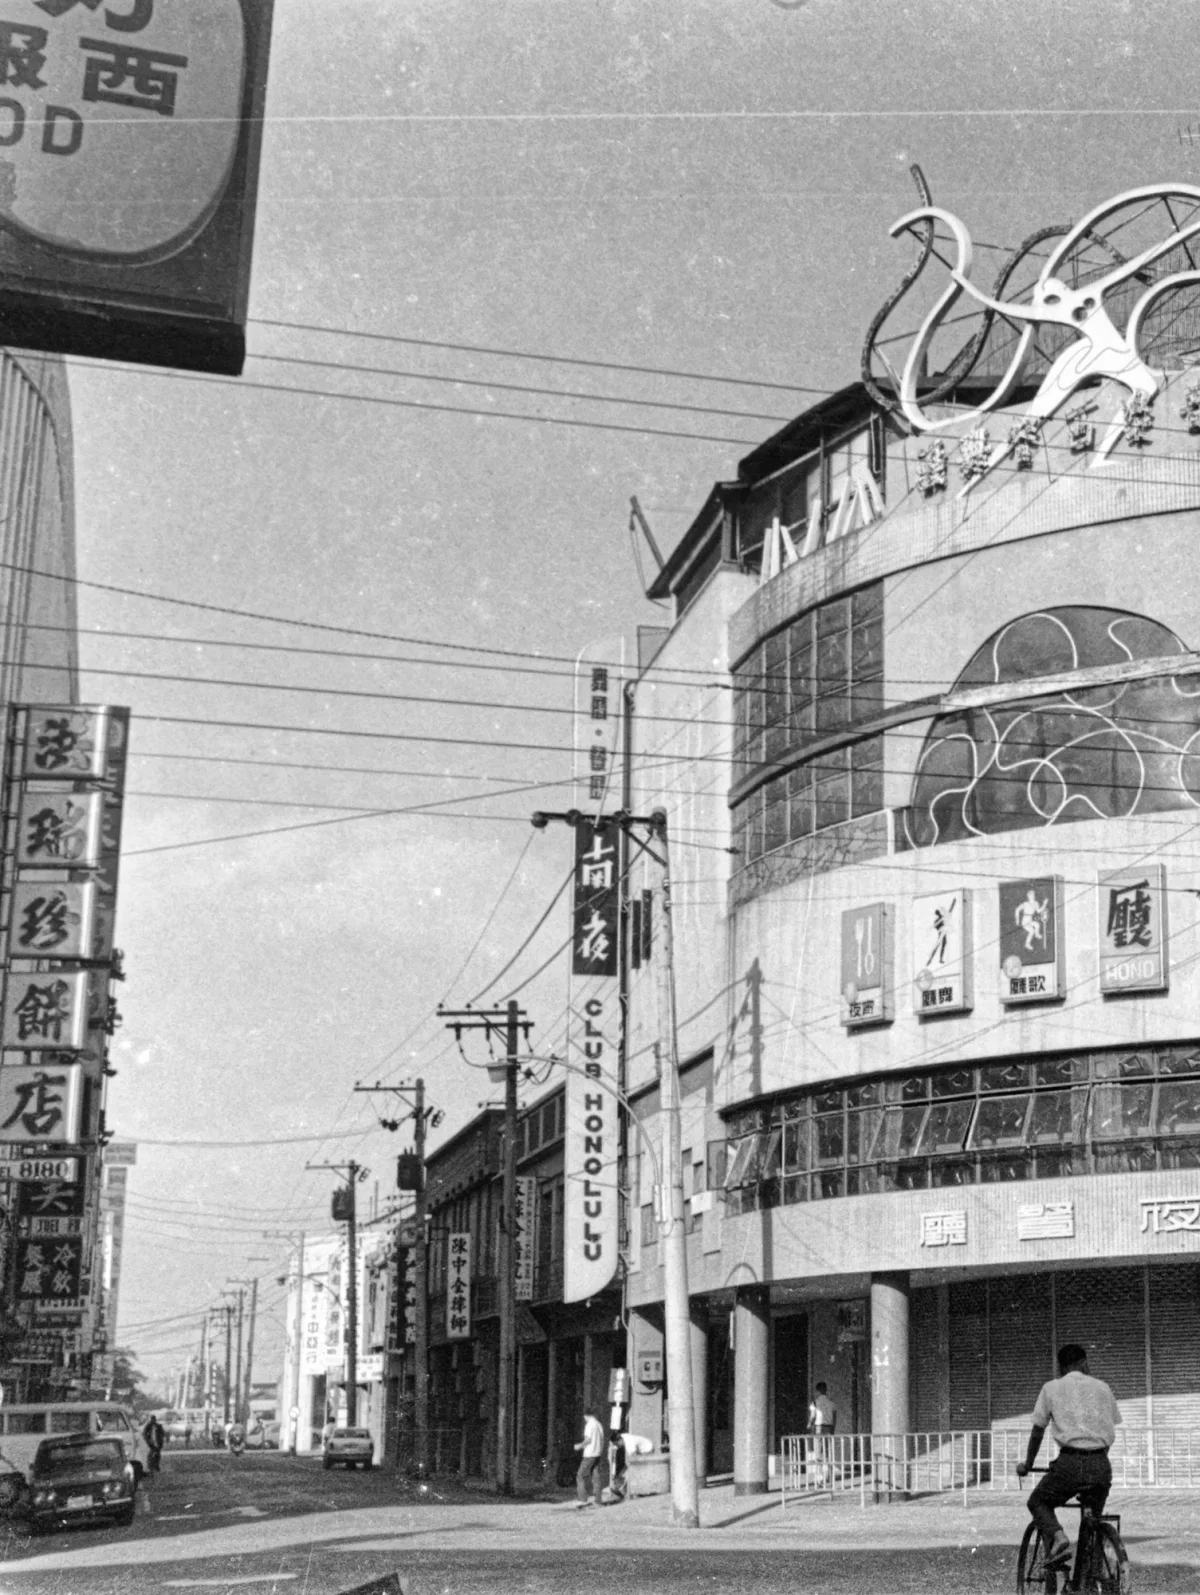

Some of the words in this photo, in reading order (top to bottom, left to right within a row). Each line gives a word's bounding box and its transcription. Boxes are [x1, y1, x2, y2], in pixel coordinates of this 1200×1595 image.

[1105, 961, 1156, 981] HONO
[585, 1000, 603, 1079] CLUB
[584, 1094, 603, 1261] HONOLULU
